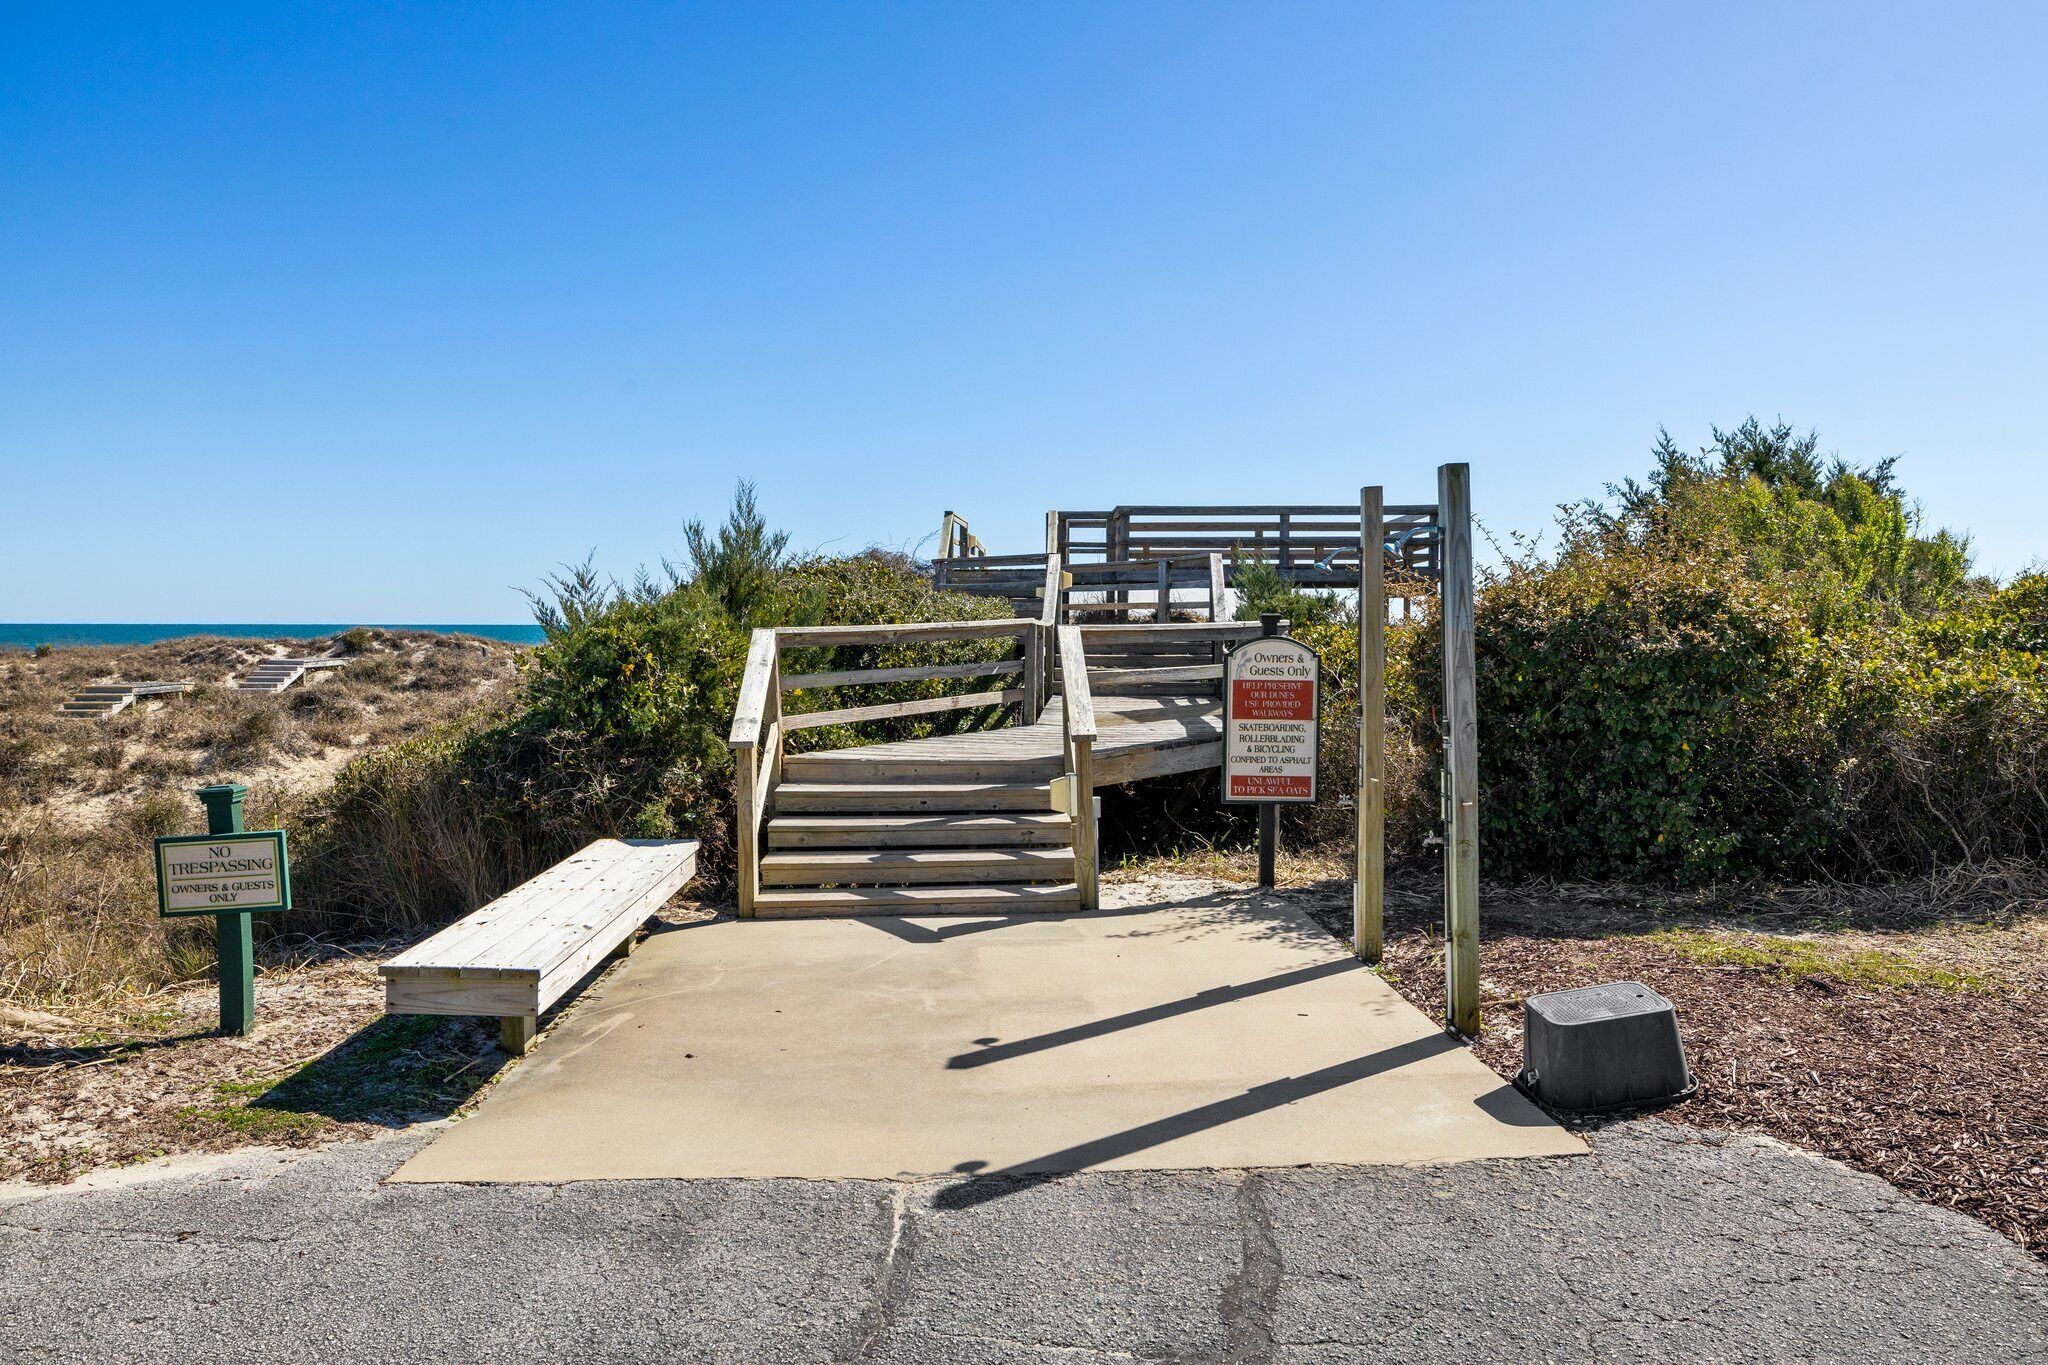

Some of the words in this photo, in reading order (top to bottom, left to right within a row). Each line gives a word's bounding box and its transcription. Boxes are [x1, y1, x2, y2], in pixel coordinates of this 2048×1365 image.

[1254, 652, 1294, 663] Owners
[1297, 654, 1304, 663] &
[1250, 665, 1284, 676] Guests
[1287, 666, 1311, 678] Only
[1264, 682, 1303, 690] PRESERVE
[1239, 723, 1306, 733] SKATEBOARDING,
[1239, 735, 1304, 743] ROLLERBLADING
[1254, 745, 1295, 753] BICYCLING
[1247, 777, 1292, 785] UNLAWFUL
[209, 846, 231, 858] NO
[169, 858, 273, 875] TRESPASSING
[171, 883, 218, 894] OWNERS
[232, 880, 274, 891] GUESTS
[209, 893, 238, 903] ONLY
